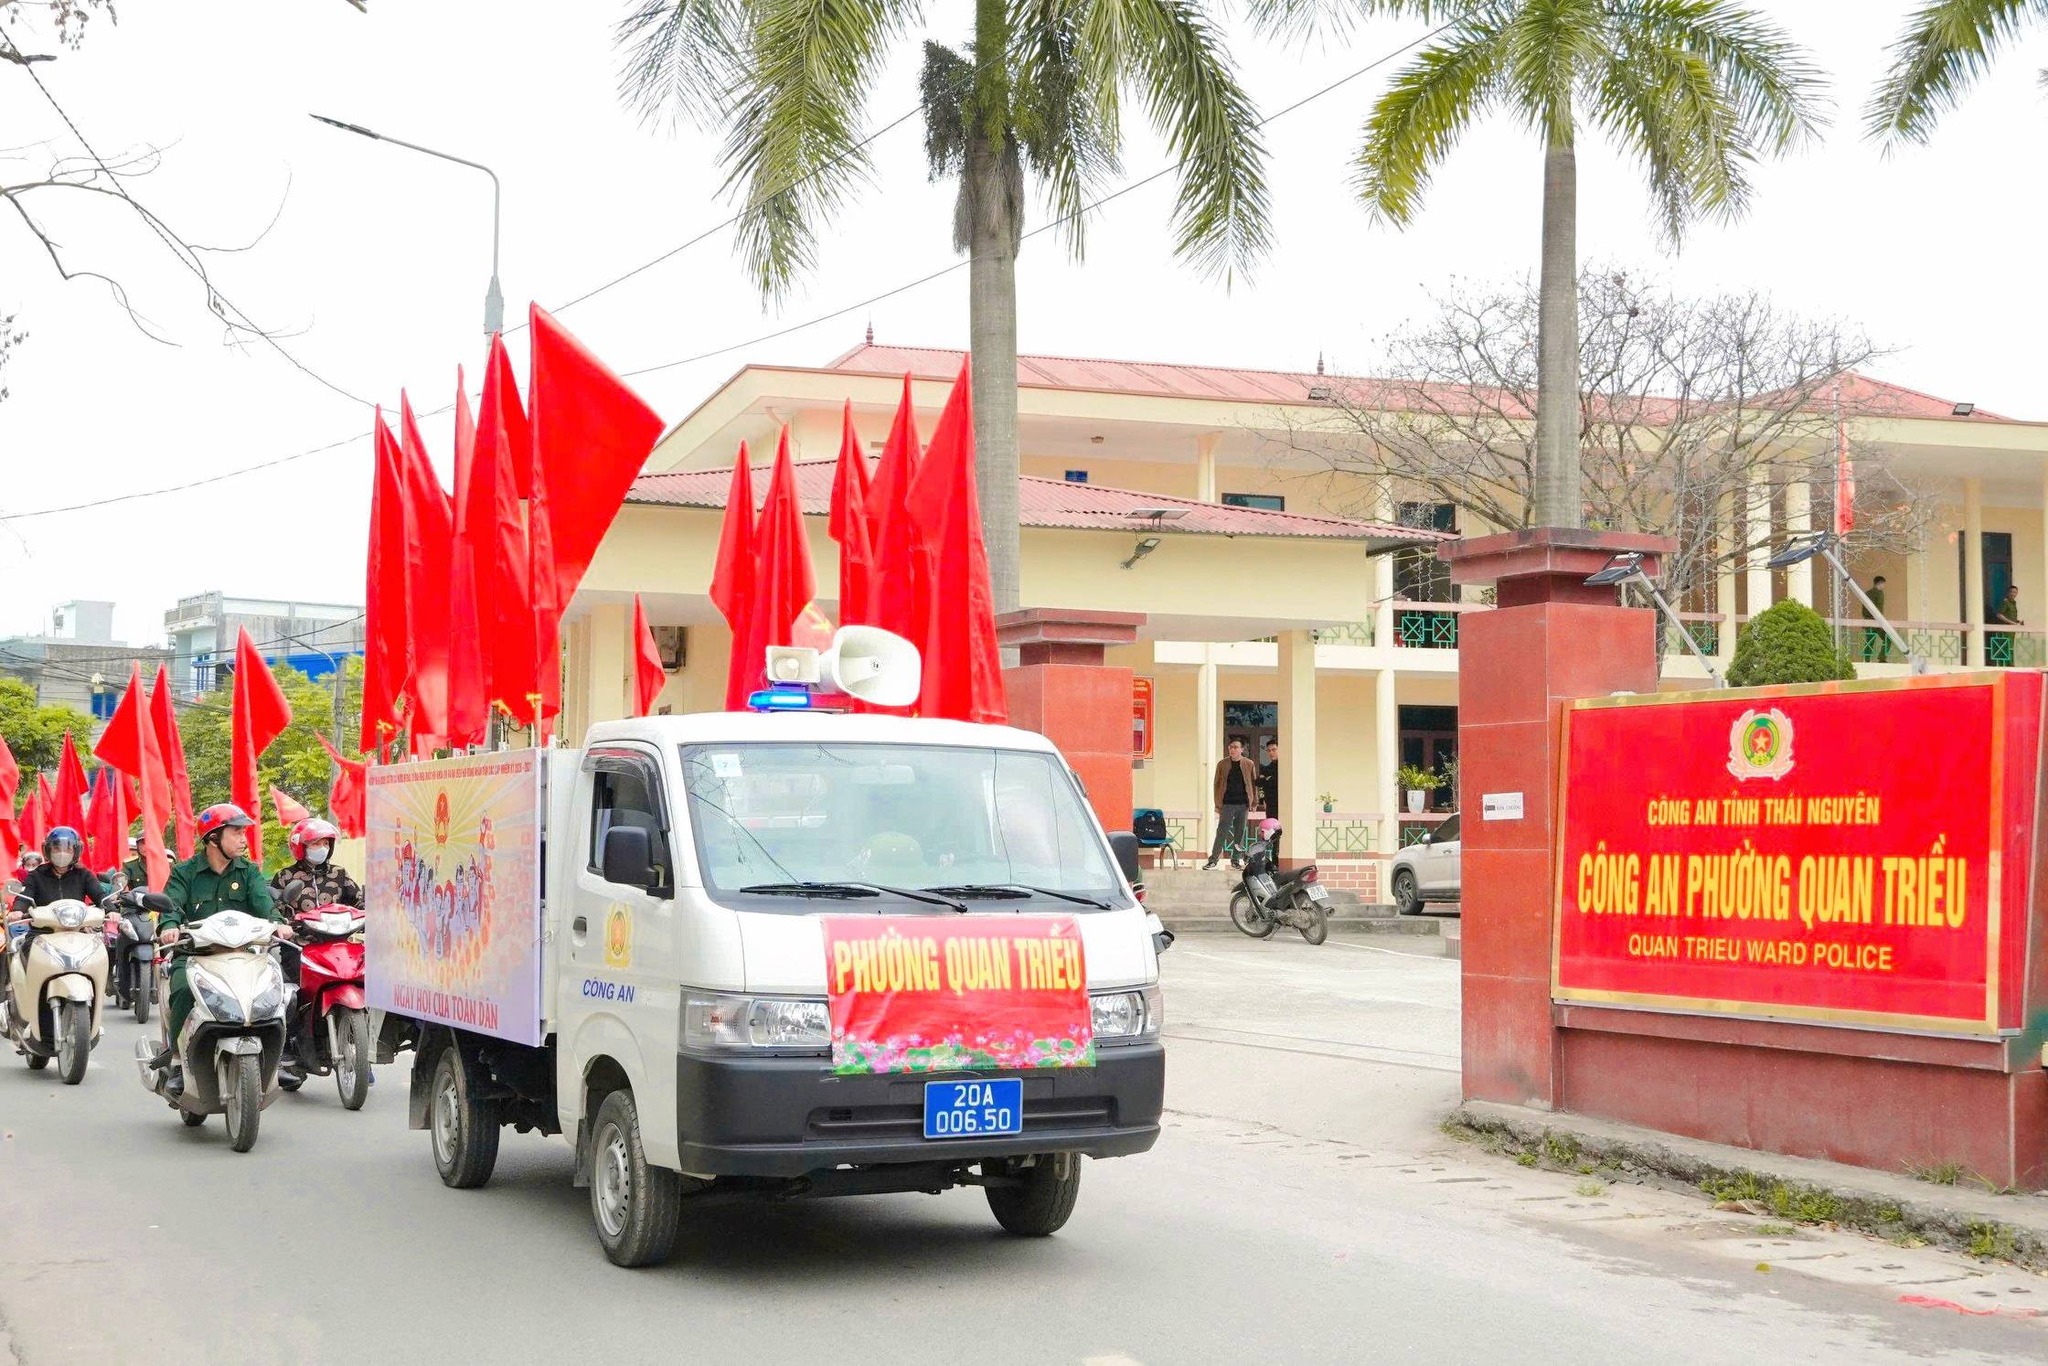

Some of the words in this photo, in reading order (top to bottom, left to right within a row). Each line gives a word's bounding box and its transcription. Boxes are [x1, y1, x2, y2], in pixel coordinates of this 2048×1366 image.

[1648, 795, 1690, 826] CÔNG
[1694, 799, 1717, 825] AN
[1723, 790, 1759, 825] TỈNH
[1765, 793, 1802, 825] THÁI
[1807, 792, 1880, 825] NGUYÊN
[1578, 840, 1640, 915] CÔNG
[1645, 854, 1680, 916] AN
[1686, 839, 1791, 921] PHƯỜNG
[1799, 855, 1874, 930] QUAN
[1882, 833, 1967, 928] TRIỀU
[833, 926, 940, 994] PHƯỜNG
[945, 937, 1012, 996] QUAN
[1014, 922, 1082, 990] TRIỀU
[1629, 934, 1678, 957] QUAN
[1685, 936, 1741, 961] TRIEU
[1746, 939, 1807, 965] WARD
[1814, 943, 1892, 970] POLICE
[583, 976, 615, 1000] CÔNG
[617, 985, 635, 1003] AN
[954, 1084, 994, 1107] 20A
[936, 1108, 1011, 1133] 006.50
